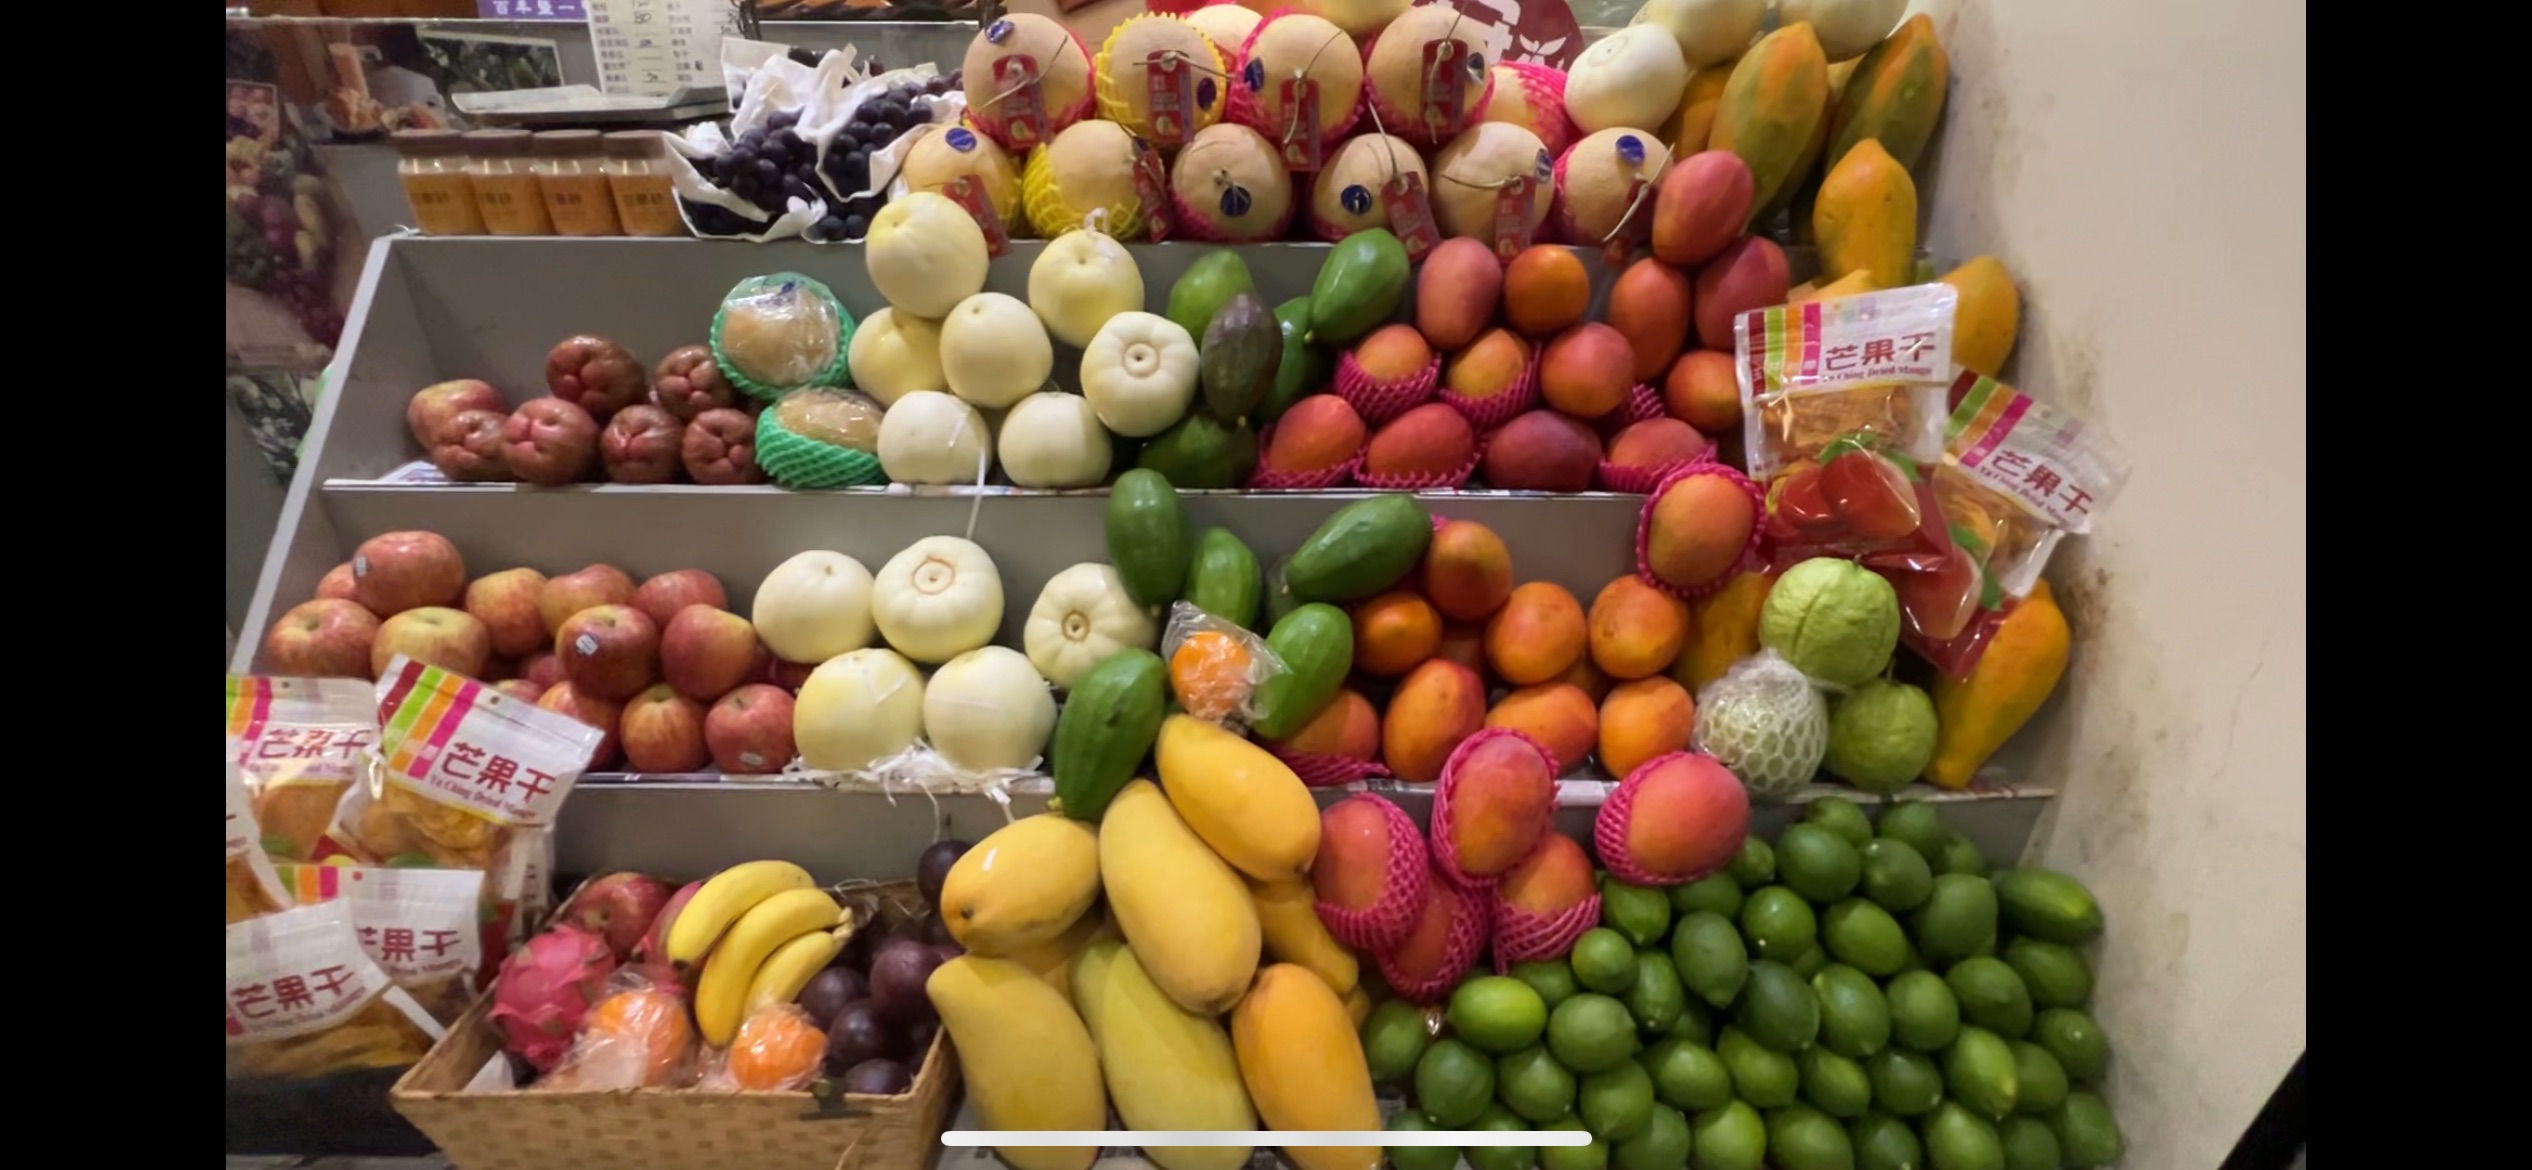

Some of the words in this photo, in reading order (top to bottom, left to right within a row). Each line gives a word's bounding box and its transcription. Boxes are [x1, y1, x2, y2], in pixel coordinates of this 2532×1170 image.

[1825, 331, 1936, 372] 芒果干
[1868, 366, 1895, 377] Dried
[1991, 449, 2093, 515] 芒果干
[258, 728, 372, 760] 芒果干
[442, 741, 556, 803] 芒果干
[231, 964, 355, 1019] 芒果干
